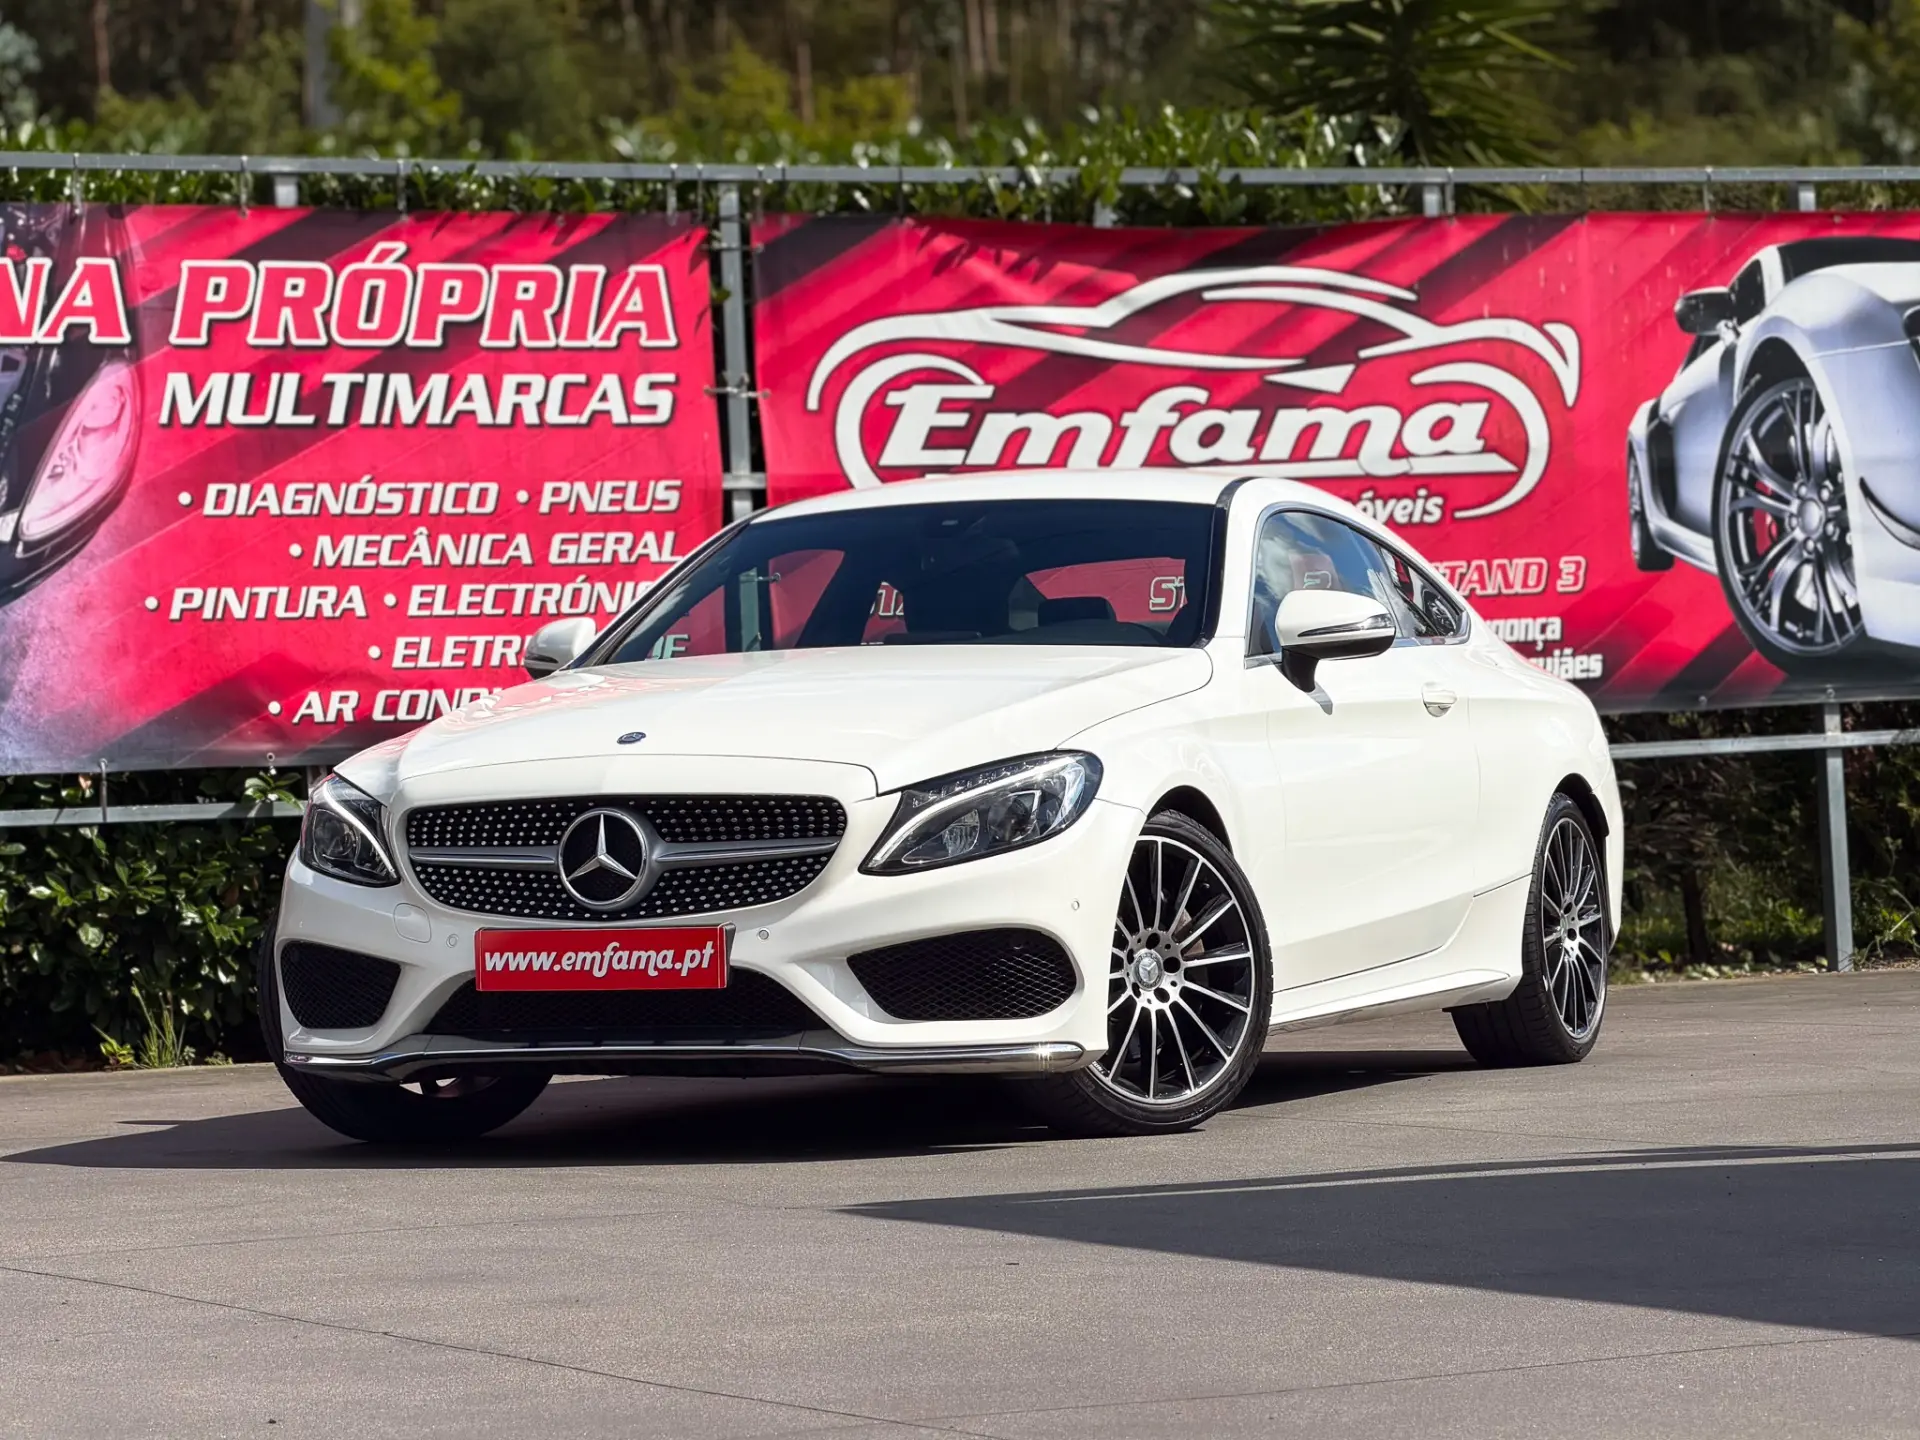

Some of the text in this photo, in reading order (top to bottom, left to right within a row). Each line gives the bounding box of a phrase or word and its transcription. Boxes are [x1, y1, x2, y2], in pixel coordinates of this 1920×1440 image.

[169, 241, 678, 348] PRÓPRIA
[159, 373, 677, 425] MULTIMARCAS
[879, 384, 1489, 477] Emfama
[203, 475, 681, 516] DIAGNÓSTICO PNEUS
[313, 527, 684, 567] MECÂNICA GERAL
[1430, 556, 1586, 597] TAND 3
[169, 575, 654, 620] PINTURA ELECTRÓNI
[392, 635, 528, 668] ELETR
[293, 687, 503, 723] AR CON
[485, 941, 714, 977] www.emfama.pt
